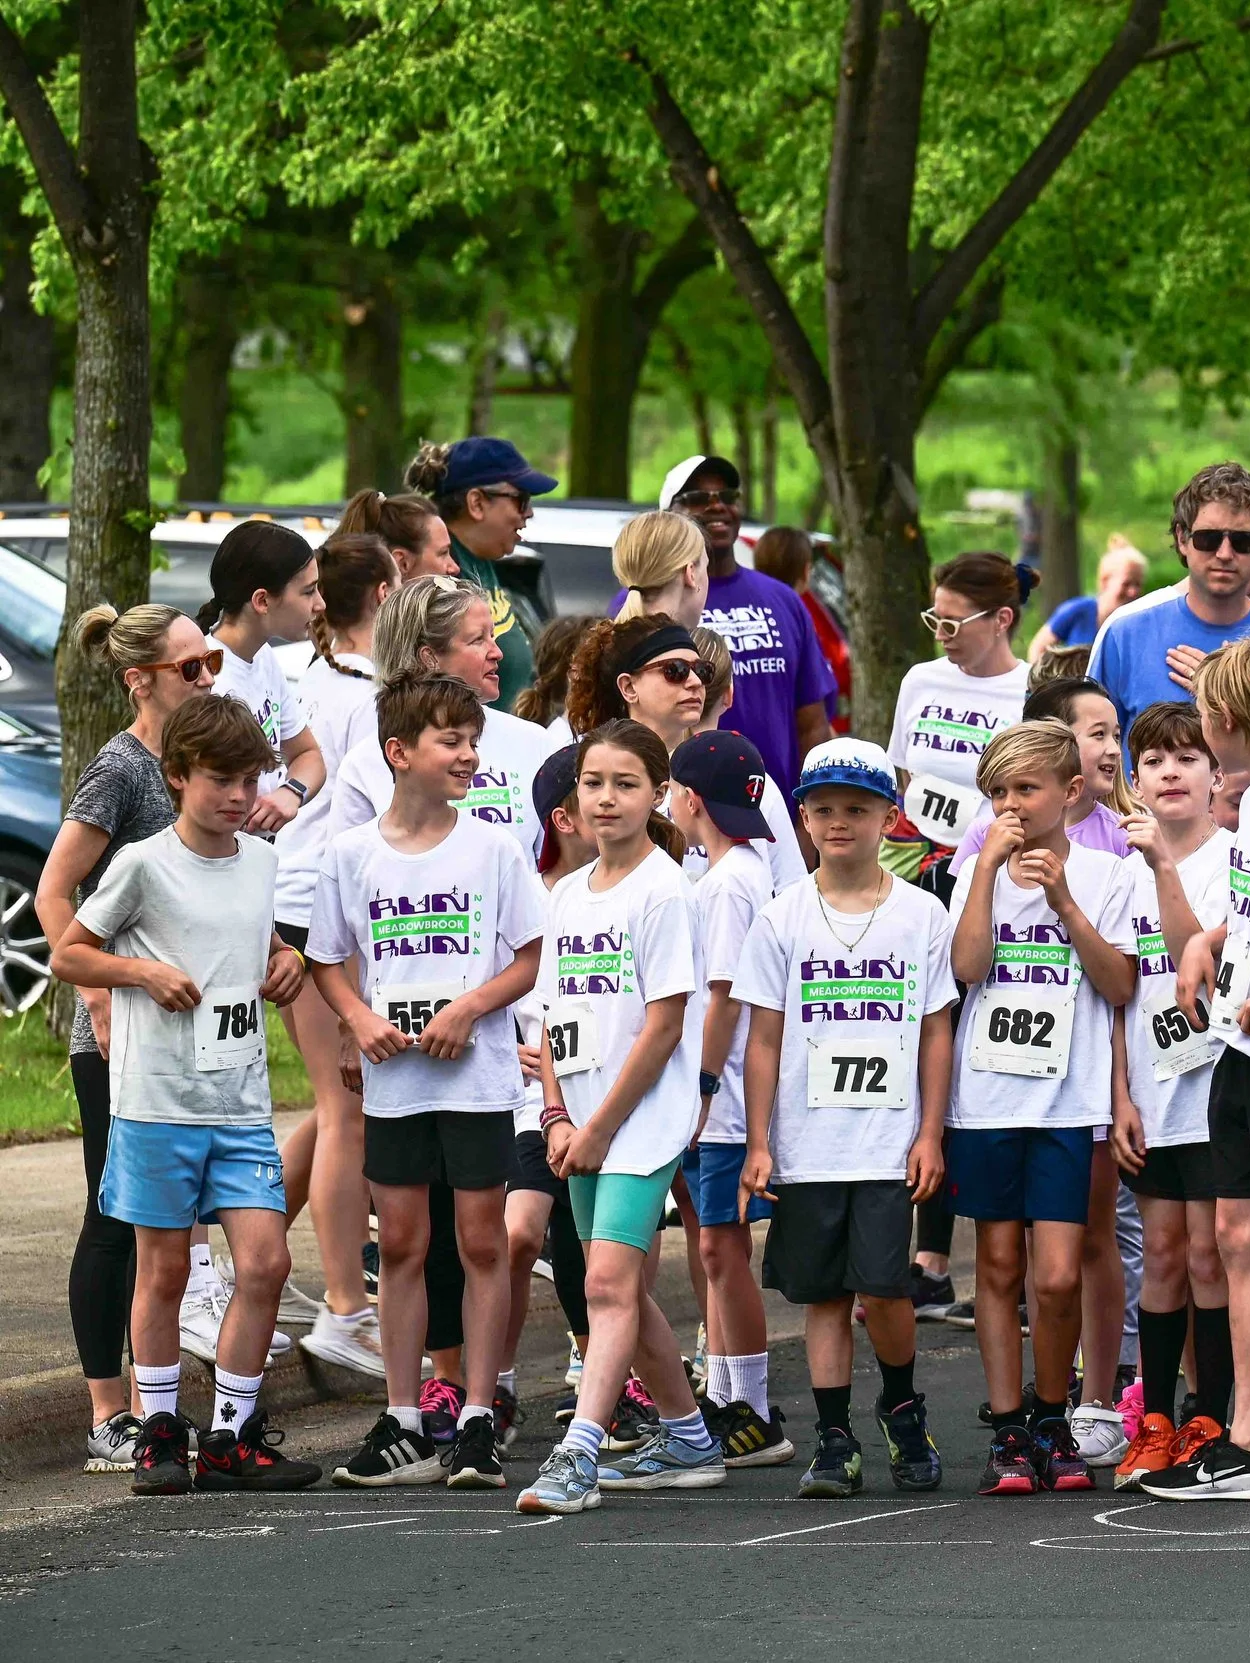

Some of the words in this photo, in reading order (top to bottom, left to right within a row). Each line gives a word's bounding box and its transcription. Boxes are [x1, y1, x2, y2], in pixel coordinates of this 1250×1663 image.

[725, 632, 774, 652] UN
[920, 705, 998, 730] RUN
[913, 732, 986, 755] RUN
[808, 758, 874, 774] MINNESOTA
[921, 788, 959, 828] 774
[369, 892, 469, 920] RUN
[378, 920, 465, 936] MEADOWBROOK
[473, 894, 482, 956] 2024
[995, 922, 1071, 944] UN
[374, 935, 469, 962] RUN
[558, 932, 623, 956] RUN
[801, 959, 905, 980] RUN
[559, 975, 619, 997] RUN
[809, 985, 899, 998] MEADOWBROOK
[907, 963, 917, 1022] 2024
[213, 998, 258, 1041] 784
[801, 1001, 904, 1022] RUN
[988, 1006, 1055, 1049] 682
[547, 1021, 579, 1064] 37
[831, 1056, 888, 1093] 772
